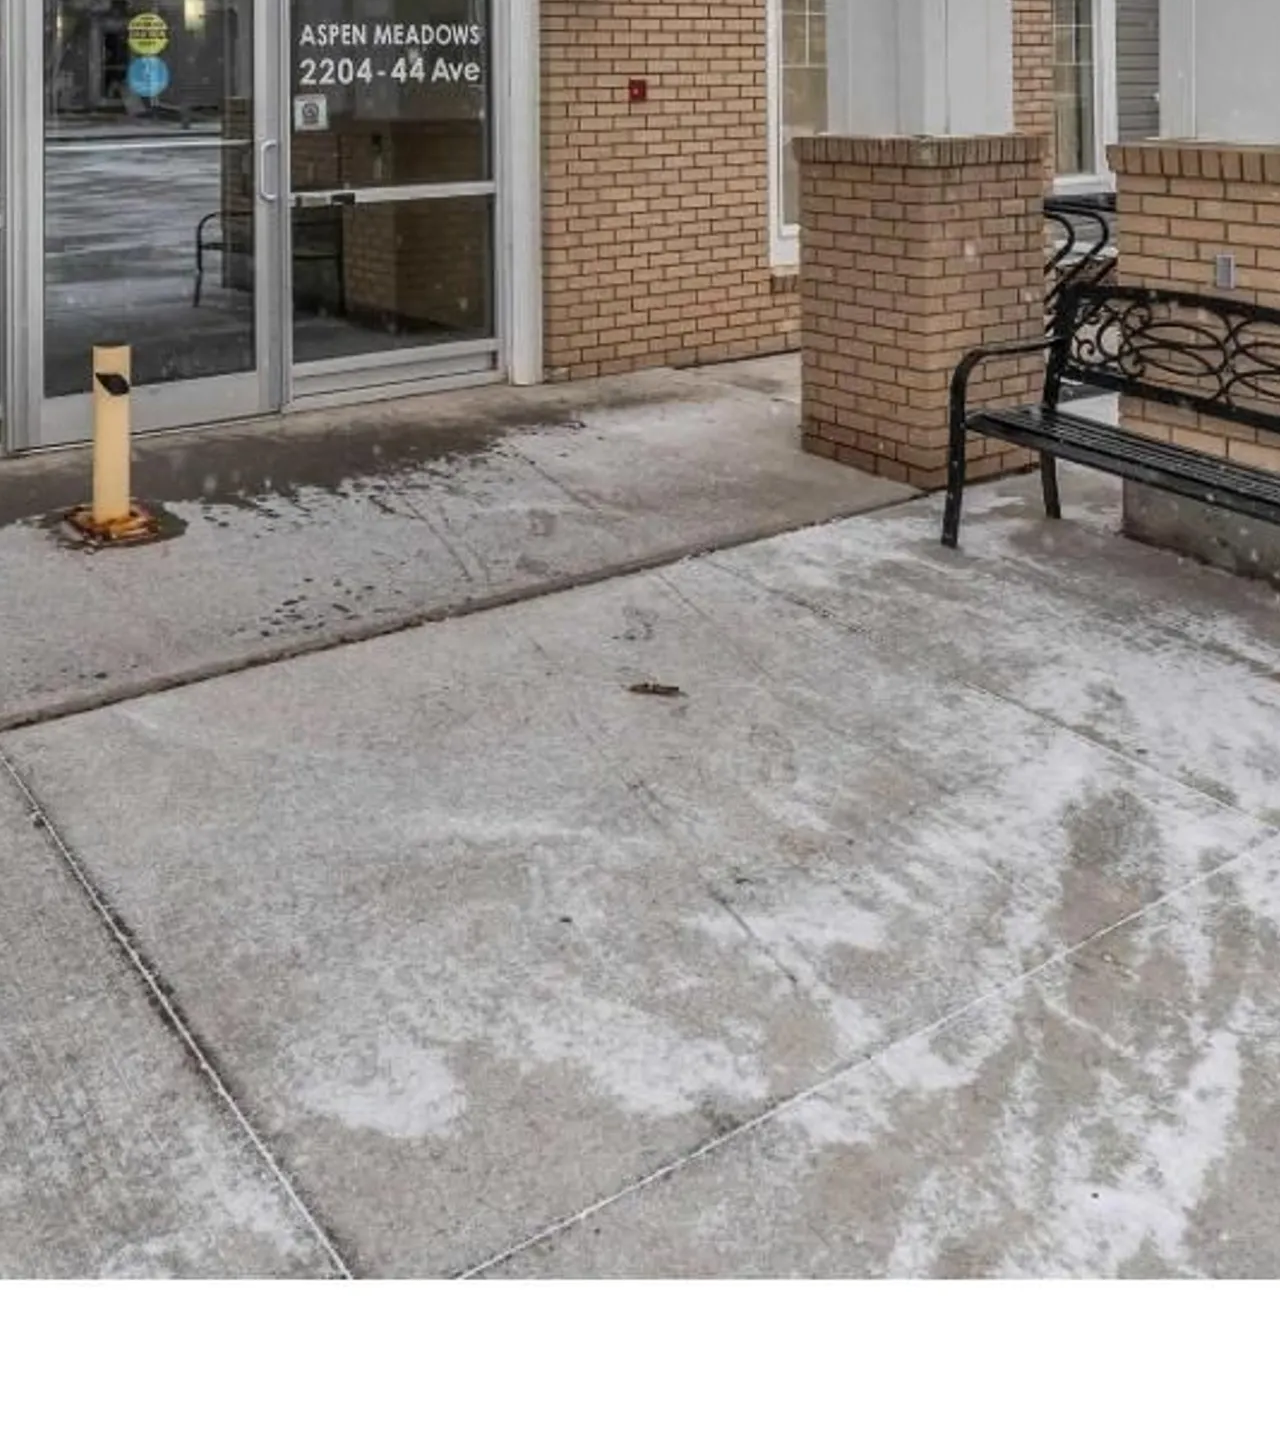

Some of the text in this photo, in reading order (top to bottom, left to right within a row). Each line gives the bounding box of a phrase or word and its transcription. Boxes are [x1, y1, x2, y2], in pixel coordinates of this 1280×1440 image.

[299, 23, 481, 47] ASPEN MEADOWS
[431, 57, 481, 83] Ave
